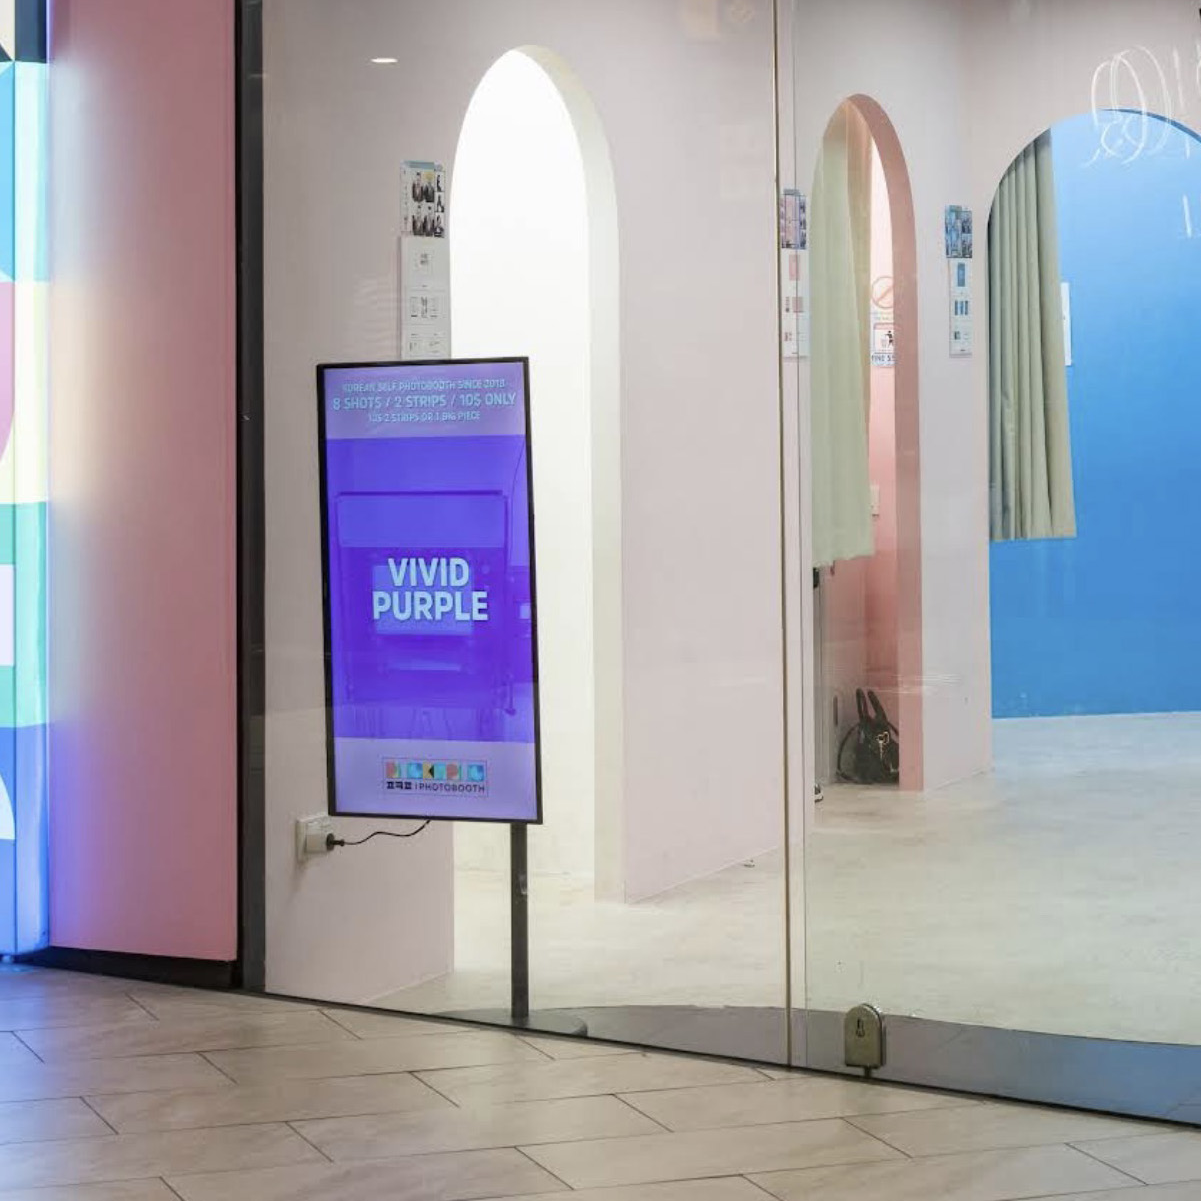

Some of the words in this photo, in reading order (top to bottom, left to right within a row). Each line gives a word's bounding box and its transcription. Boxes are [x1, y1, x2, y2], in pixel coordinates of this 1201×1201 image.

[332, 398, 341, 411] 8
[344, 396, 382, 410] SHOTS
[395, 395, 402, 407] 2
[406, 394, 447, 408] STRIPS
[485, 391, 517, 406] ONLY
[387, 557, 470, 587] VIVID
[372, 591, 489, 621] PURPLE
[419, 782, 485, 794] PHOTOBOOTH
